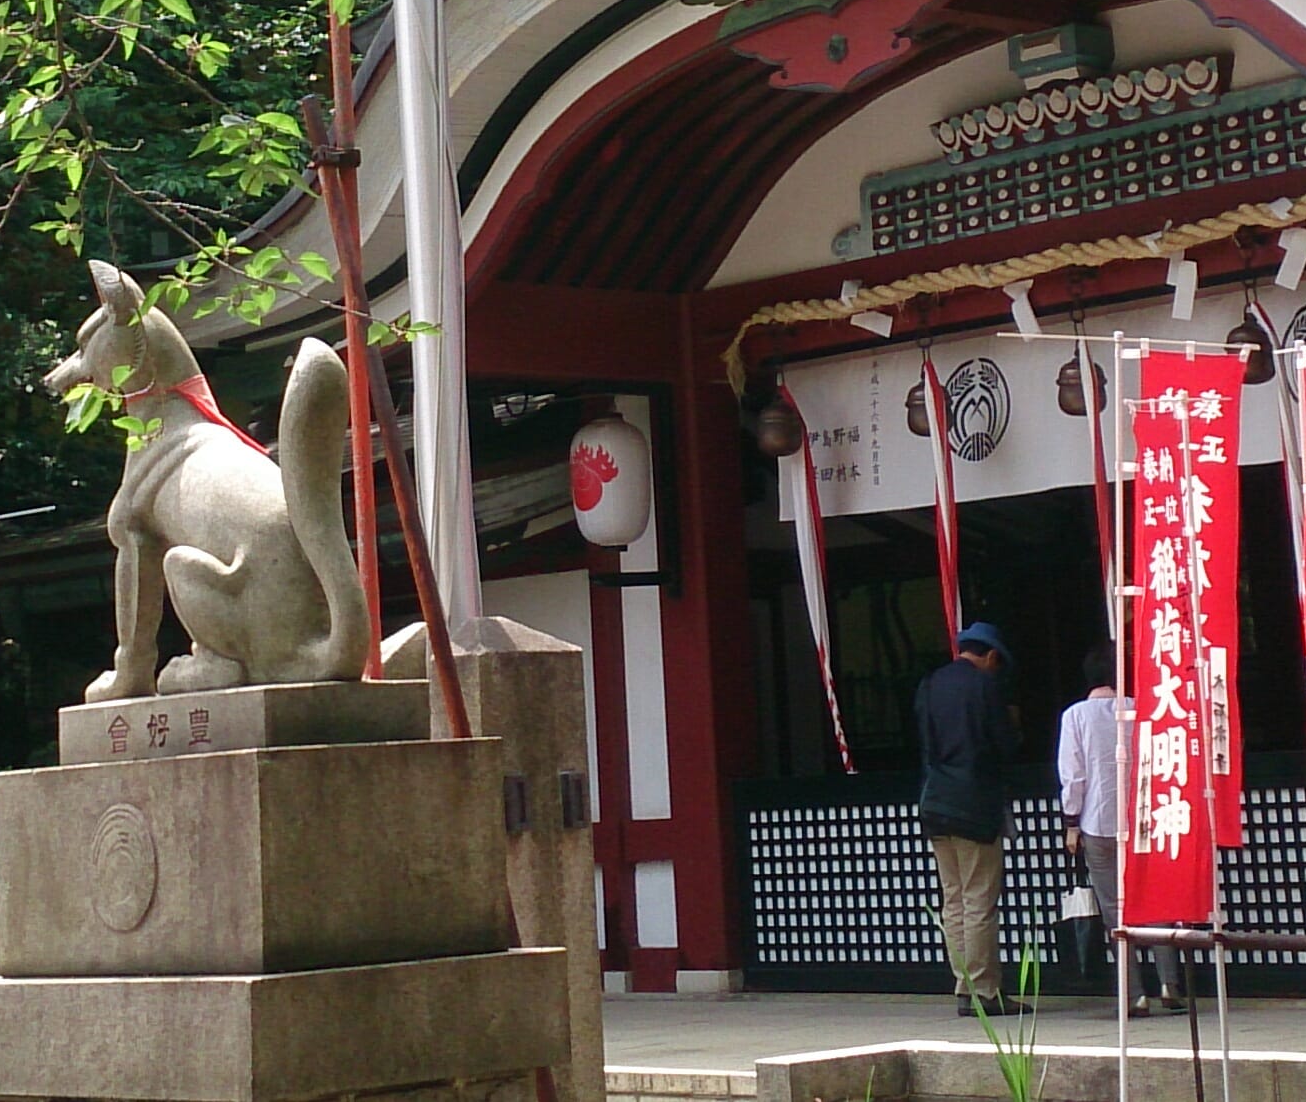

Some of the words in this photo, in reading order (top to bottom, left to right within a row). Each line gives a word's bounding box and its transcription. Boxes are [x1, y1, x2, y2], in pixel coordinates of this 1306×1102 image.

[1143, 447, 1174, 485] 奉納
[1143, 495, 1180, 526] 正一位
[1150, 537, 1191, 860] 稲荷大明神
